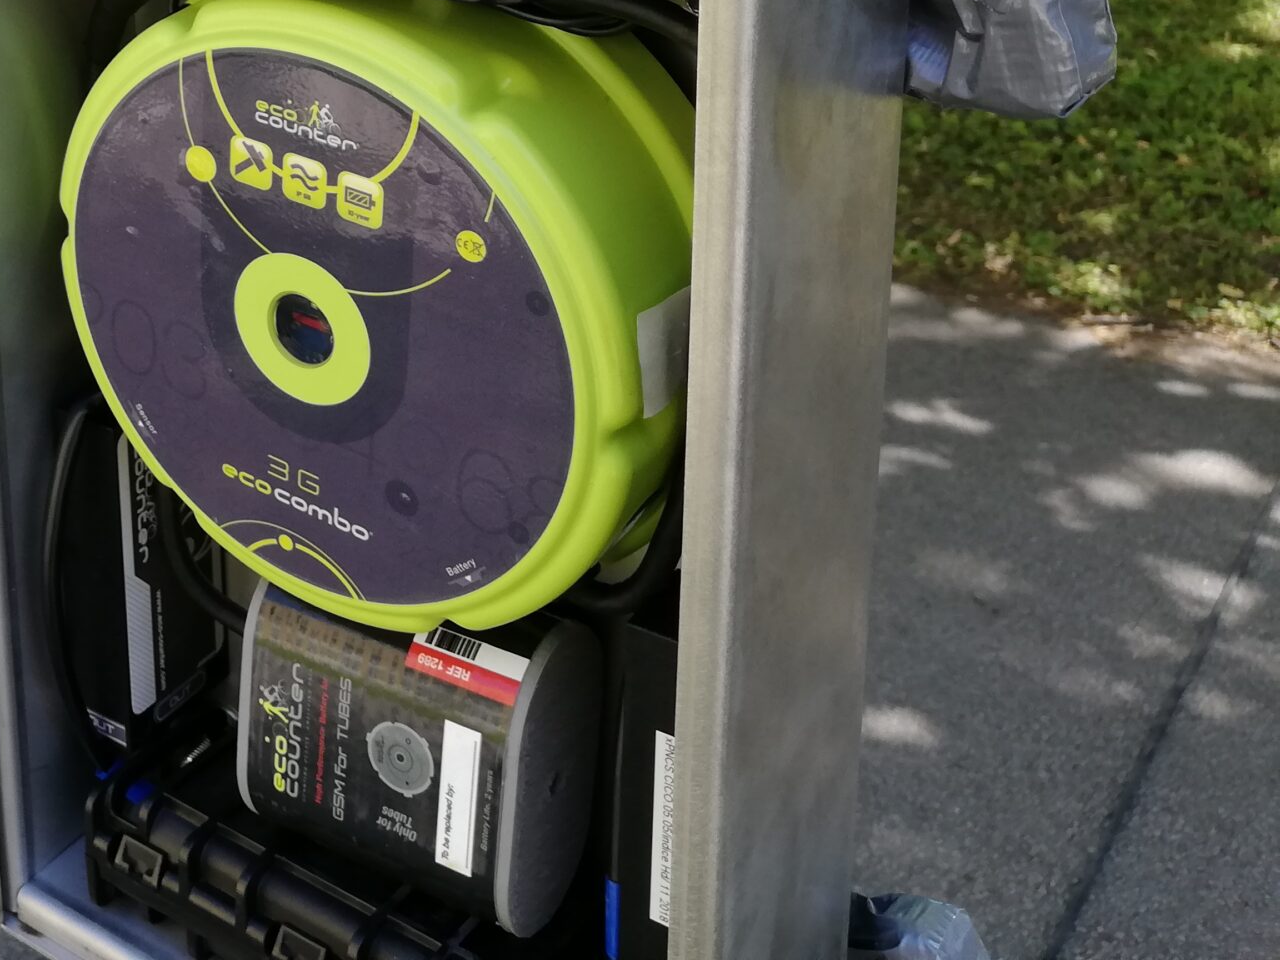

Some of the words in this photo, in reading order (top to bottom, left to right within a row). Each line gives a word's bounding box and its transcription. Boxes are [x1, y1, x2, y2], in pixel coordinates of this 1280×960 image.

[255, 100, 298, 122] eco
[255, 111, 357, 151] counter
[135, 403, 158, 435] Sensor
[134, 448, 149, 563] ounter
[446, 558, 477, 578] Battery
[418, 652, 444, 671] 1289
[447, 664, 471, 682] REF
[337, 677, 352, 740] TUBES
[286, 662, 304, 798] counter
[273, 735, 288, 792] eco
[333, 782, 346, 821] GSM
[381, 805, 413, 829] Tubes
[444, 798, 454, 837] replaced
[376, 815, 393, 831] for
[392, 822, 417, 842] Only
